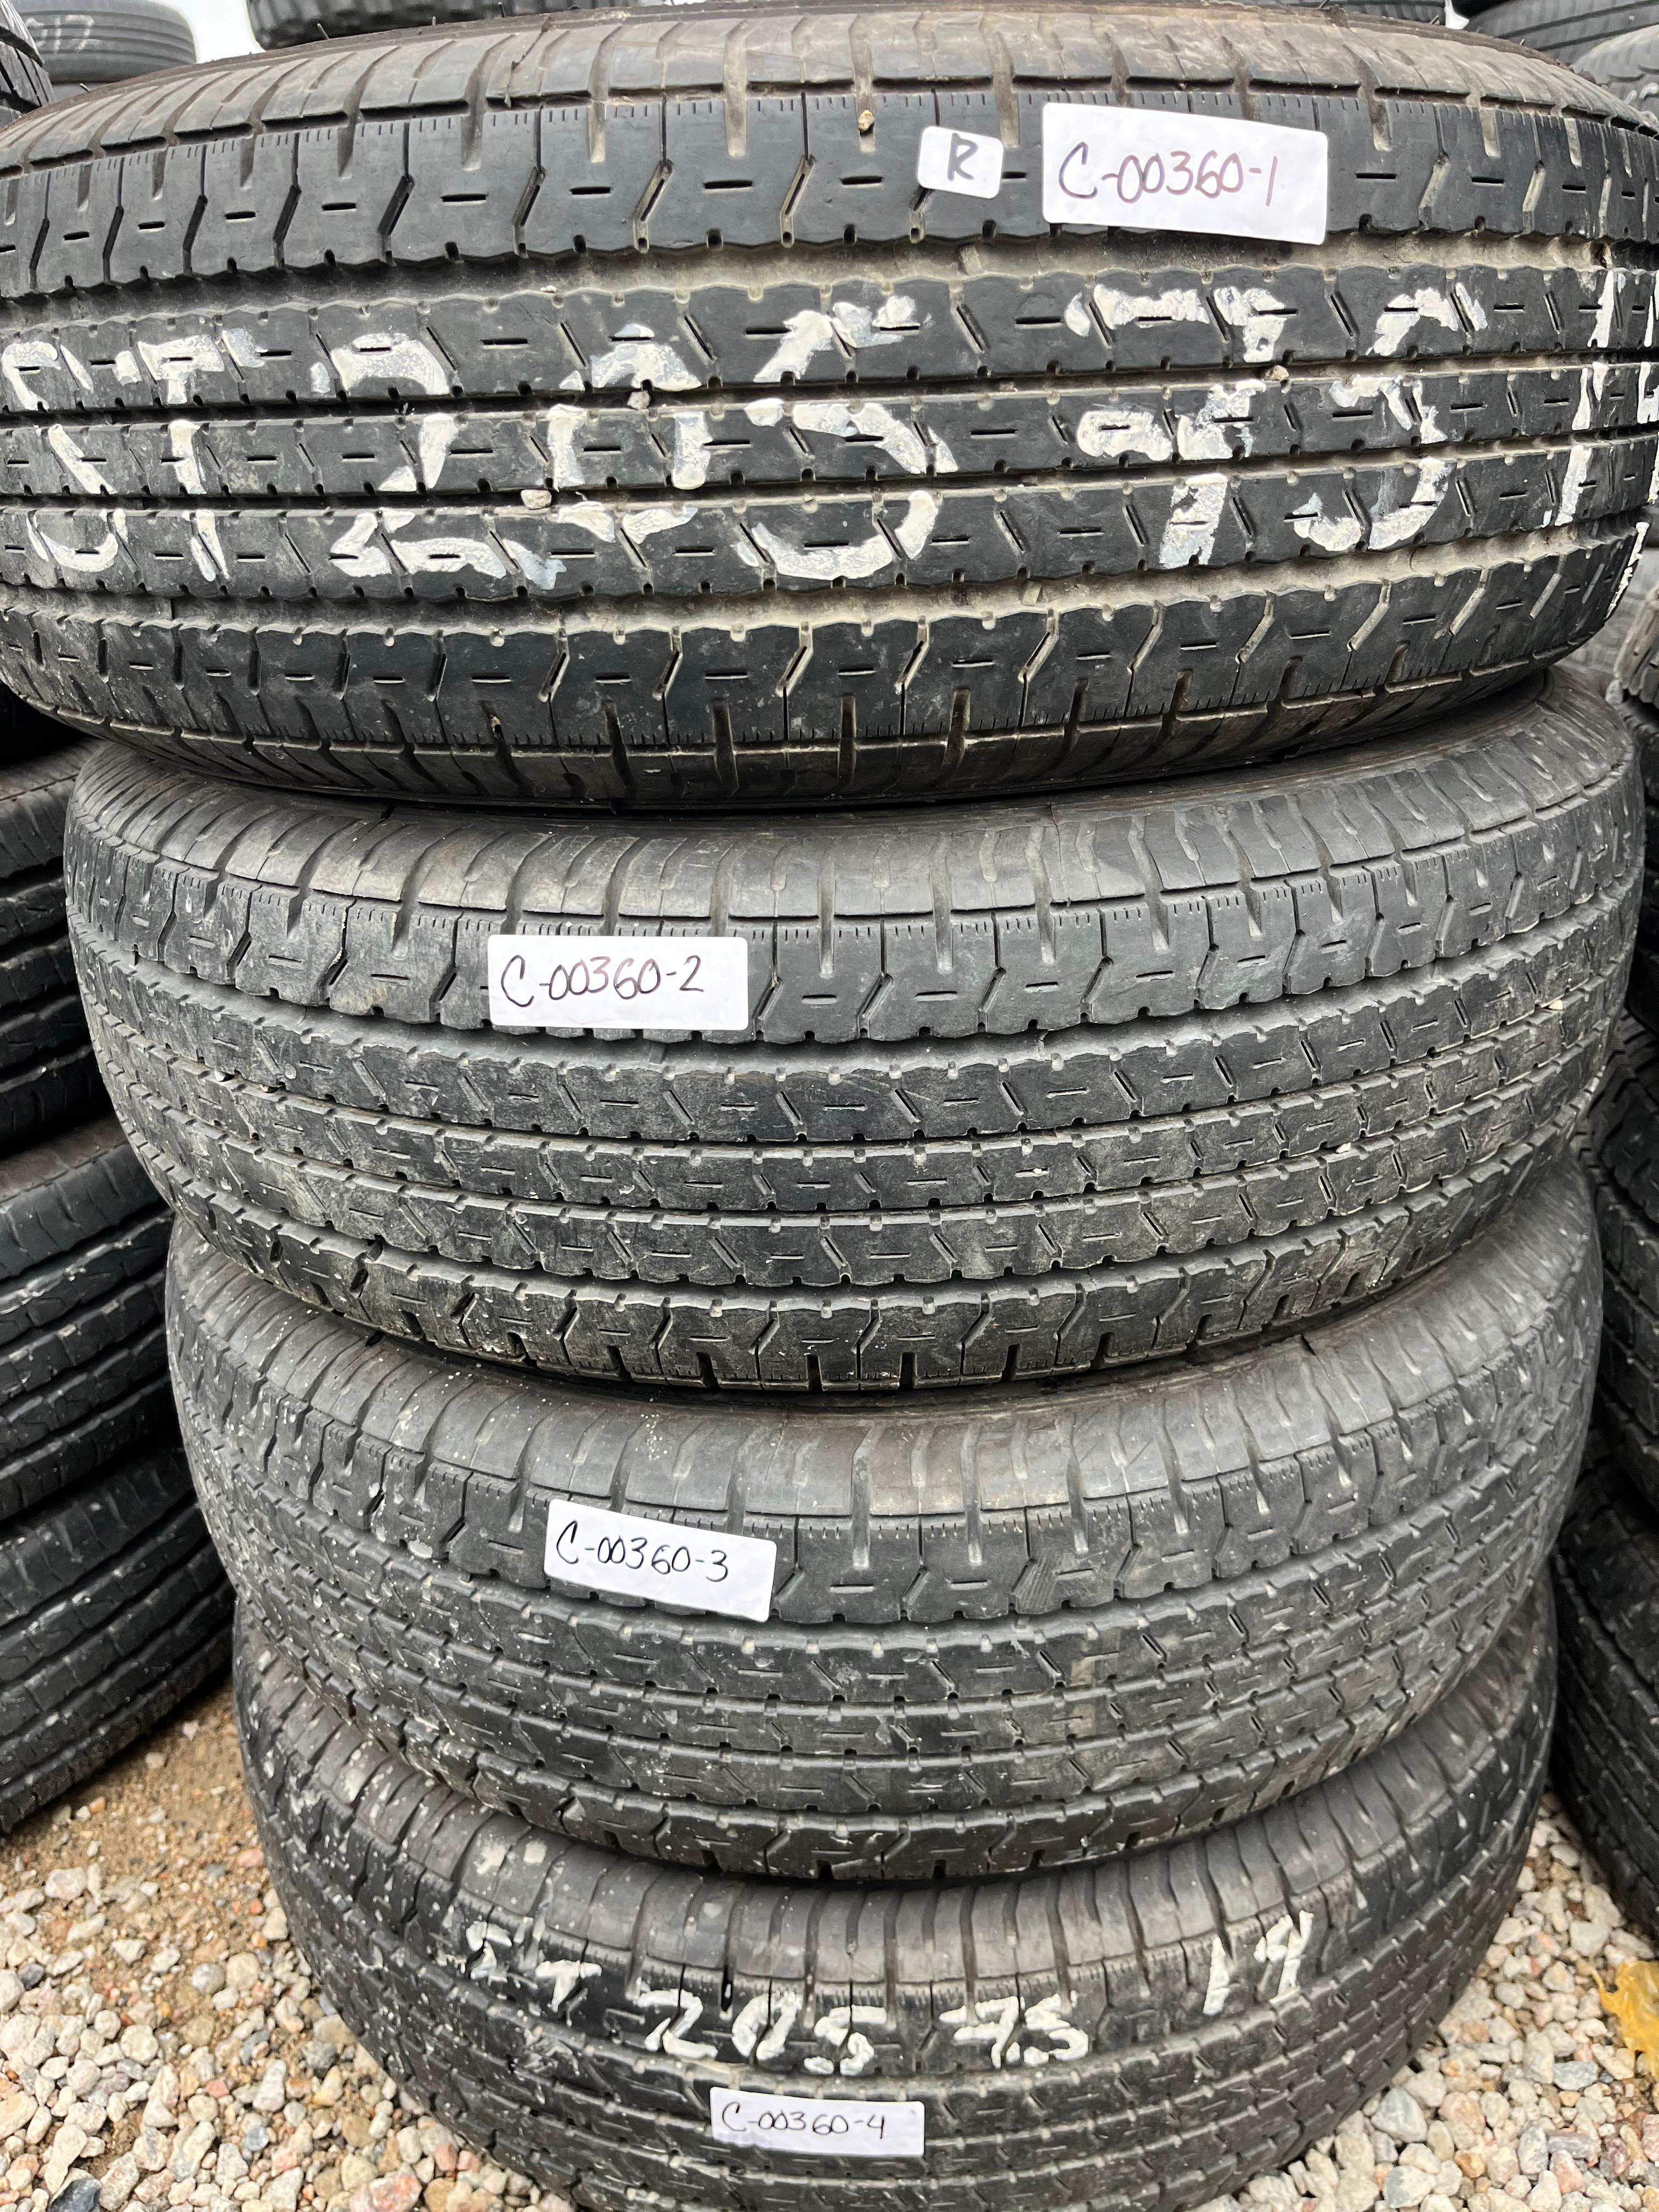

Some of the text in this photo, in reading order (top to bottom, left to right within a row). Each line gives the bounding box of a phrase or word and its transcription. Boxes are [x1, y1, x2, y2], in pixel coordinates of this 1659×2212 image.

[947, 133, 979, 182] R
[1058, 142, 1279, 207] C-00360-1
[500, 955, 704, 1008] C-00360-2
[556, 1520, 729, 1582] C-00360-3
[639, 1988, 887, 2076] 205
[939, 1989, 1090, 2068] 75
[722, 2101, 885, 2139] C-00360-4
